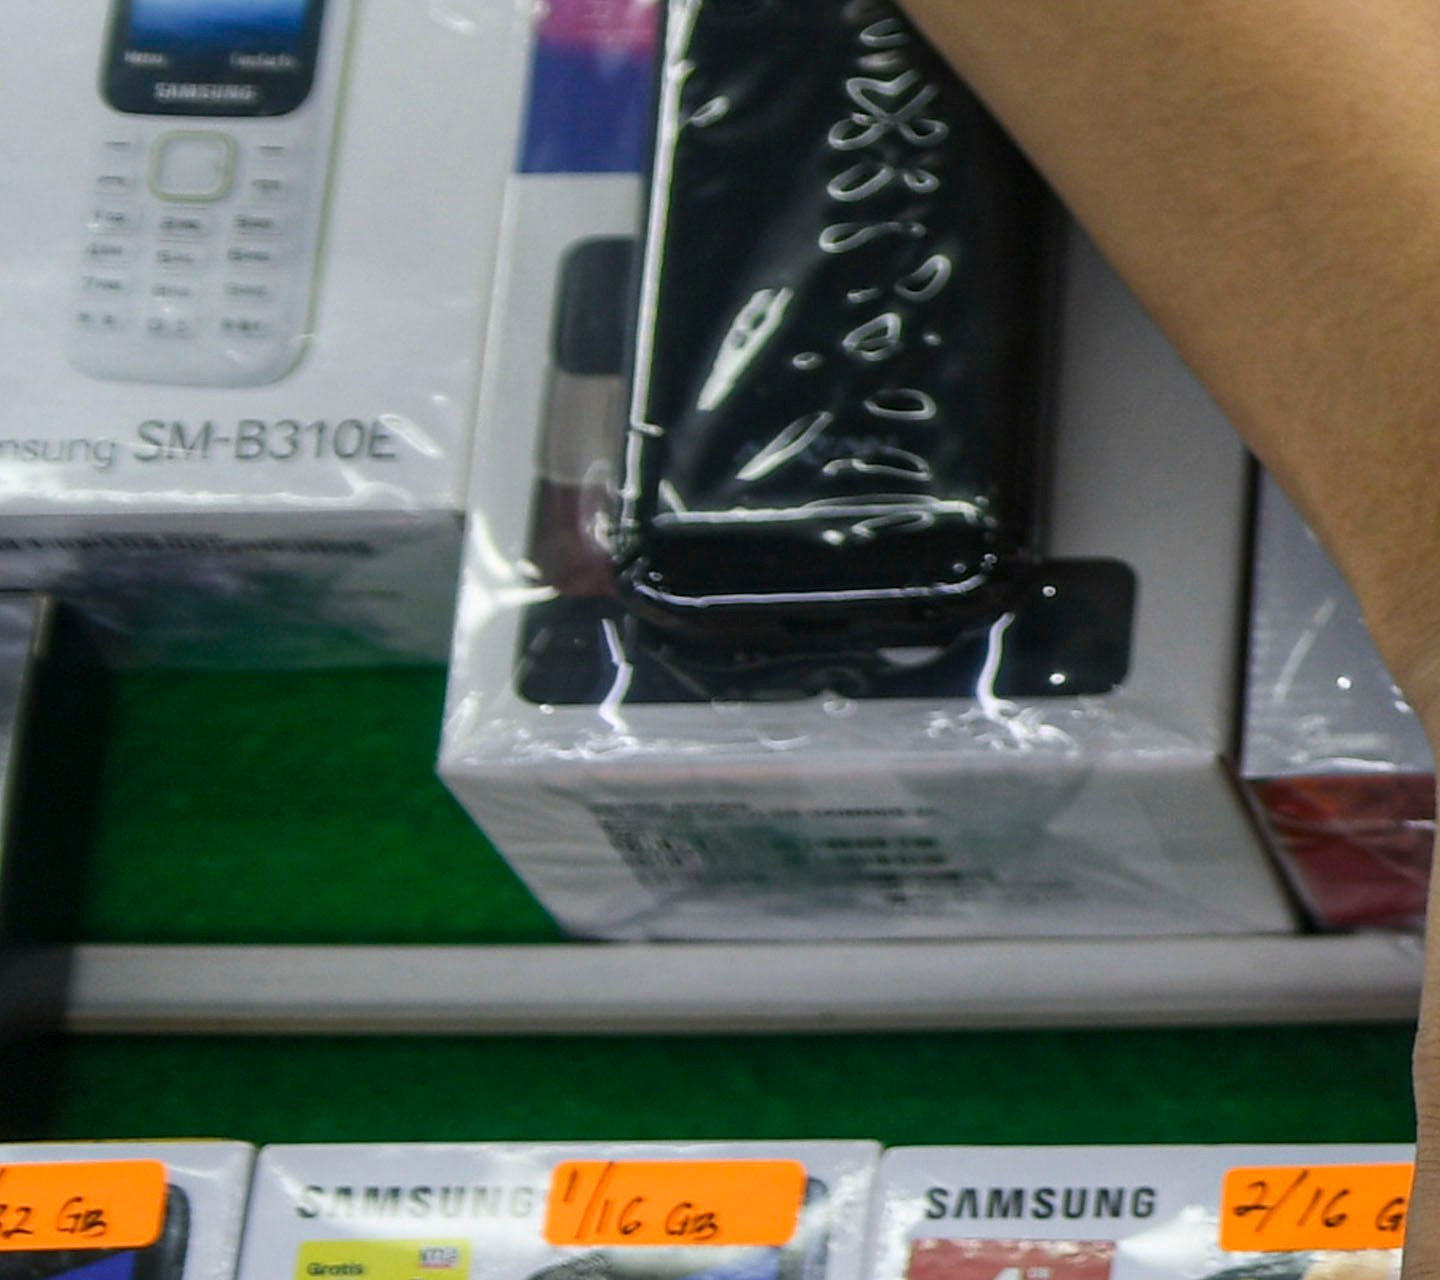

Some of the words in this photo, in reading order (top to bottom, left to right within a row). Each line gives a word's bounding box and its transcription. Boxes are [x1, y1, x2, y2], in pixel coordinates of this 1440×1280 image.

[134, 419, 398, 463] SM-B310E
[297, 1184, 535, 1218] SAMSUNG
[925, 1186, 1158, 1219] SAMSUNG
